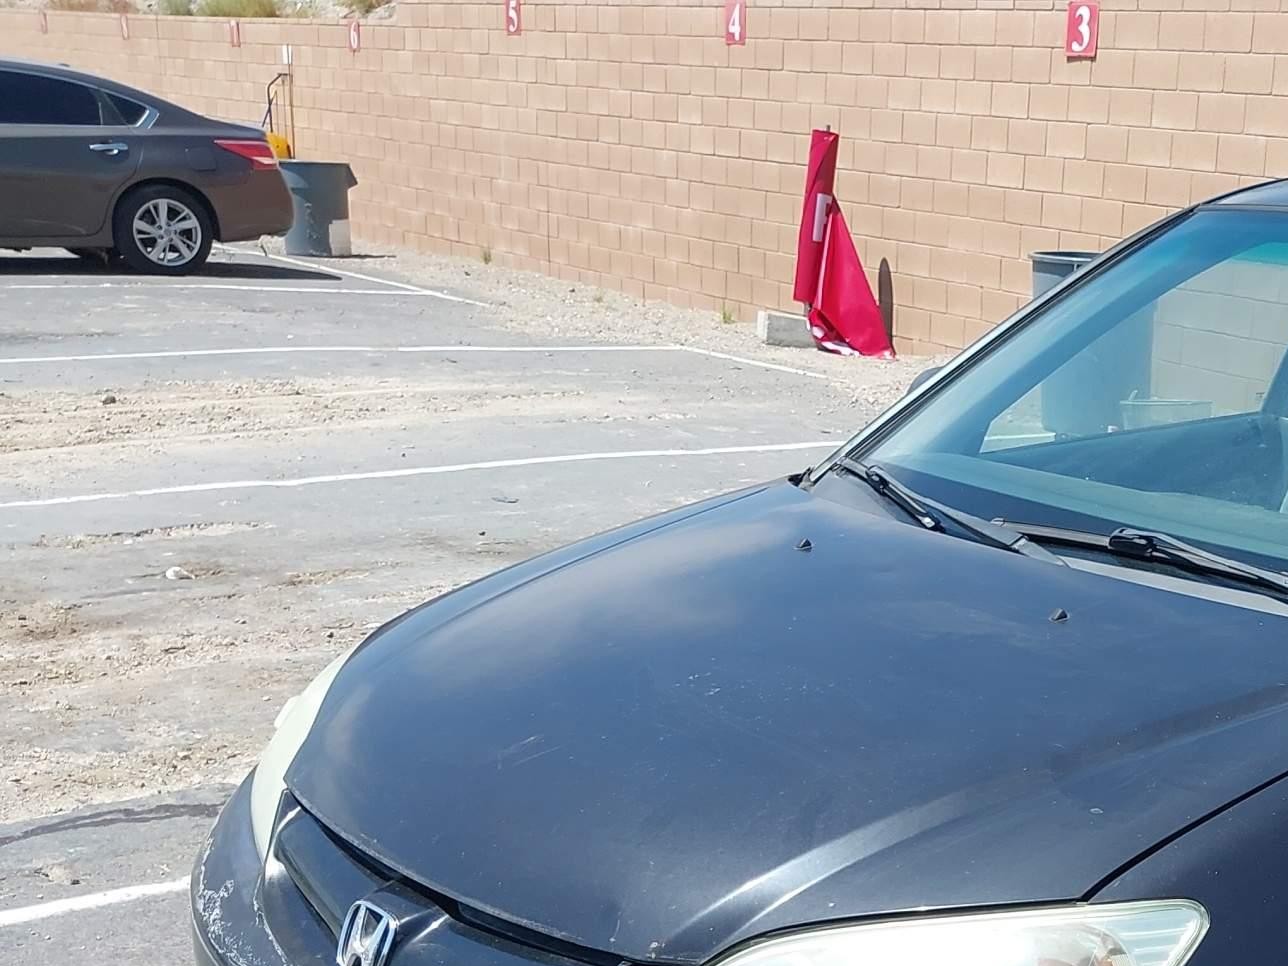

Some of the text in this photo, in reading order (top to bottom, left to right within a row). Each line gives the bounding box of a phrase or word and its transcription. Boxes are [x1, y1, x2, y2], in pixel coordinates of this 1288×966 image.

[509, 0, 517, 32] 5
[728, 3, 741, 41] 4
[1071, 5, 1090, 52] 3
[350, 22, 358, 49] 6
